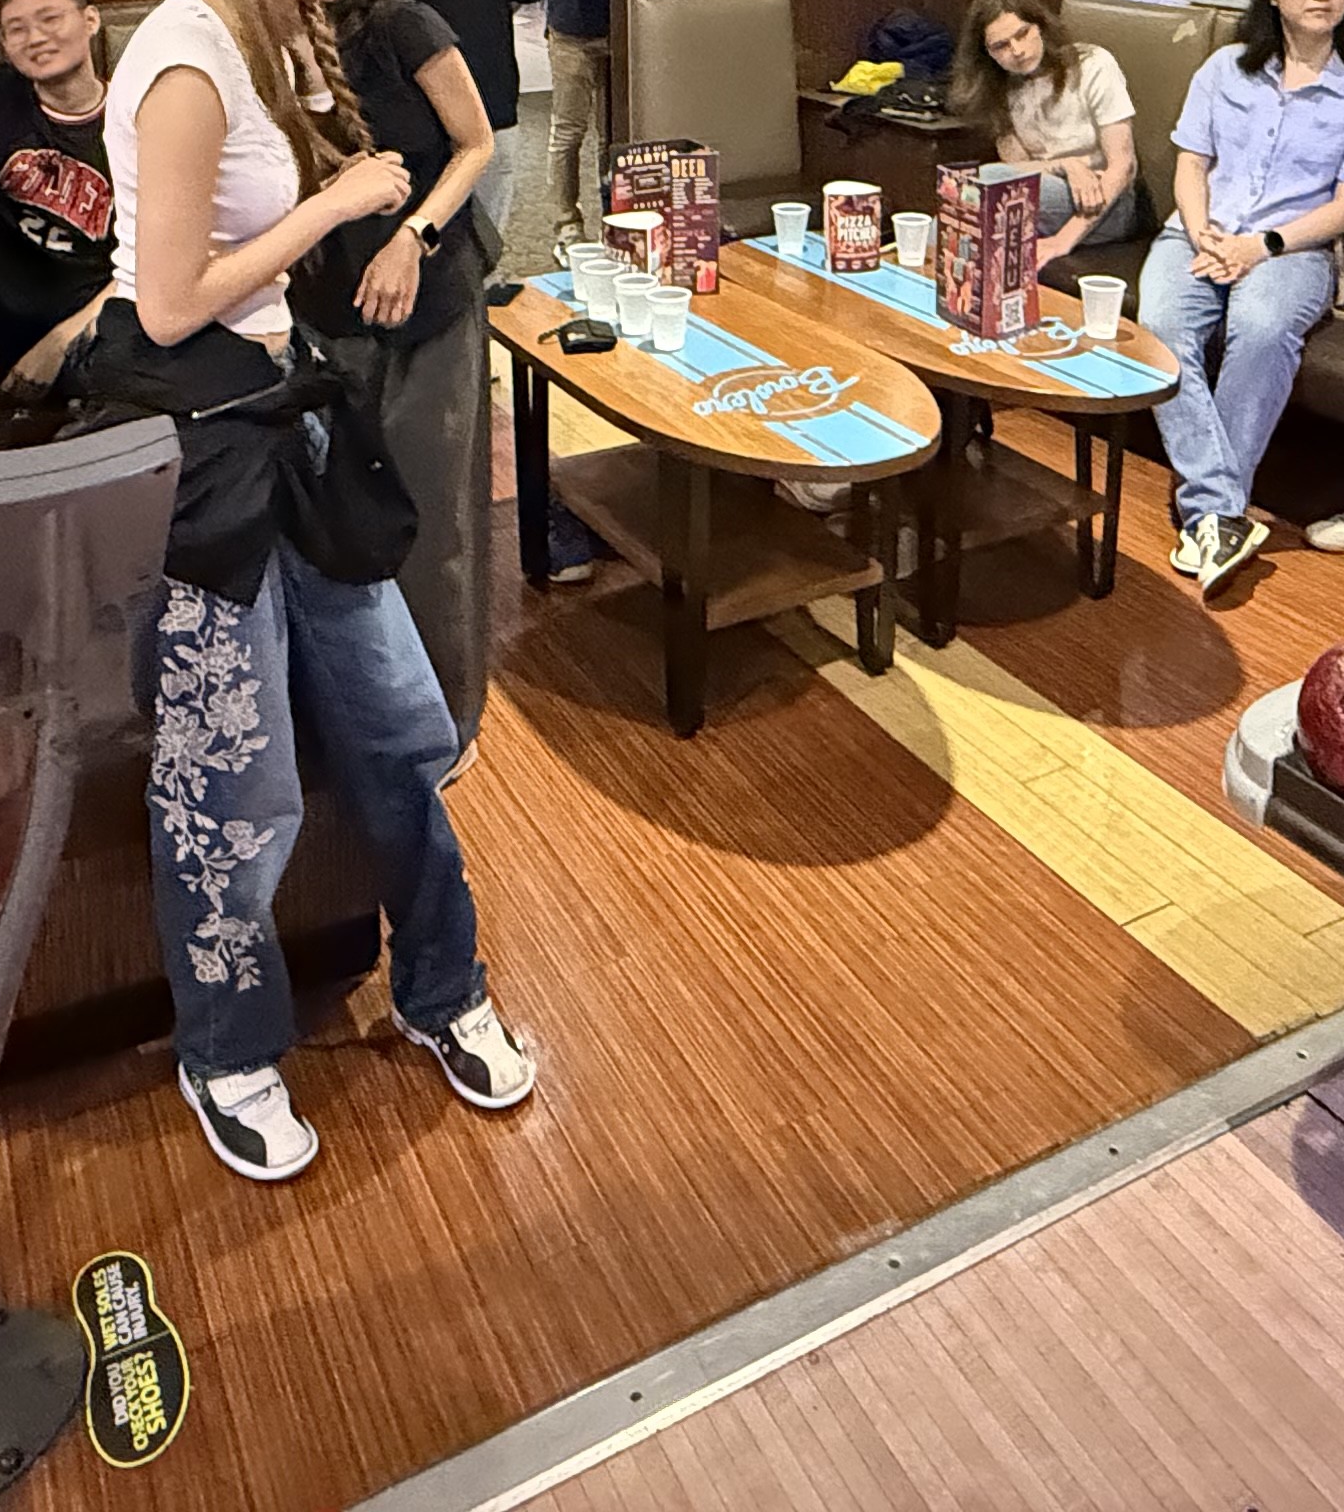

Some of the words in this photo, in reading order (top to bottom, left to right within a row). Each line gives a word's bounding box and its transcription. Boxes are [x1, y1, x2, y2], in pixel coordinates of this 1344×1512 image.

[671, 158, 706, 178] BEER
[837, 214, 872, 229] PIZZA
[1006, 207, 1022, 288] MENU
[692, 366, 860, 417] Bowlero
[91, 1267, 114, 1316] SOLES
[106, 1261, 127, 1312] CAUSE
[99, 1315, 119, 1351] WET
[115, 1310, 133, 1346] CAN
[106, 1361, 123, 1395] YOU
[120, 1356, 139, 1401] YOUR
[133, 1349, 168, 1436] SHOES?
[112, 1394, 129, 1426] DID
[126, 1399, 149, 1452] CHECK
